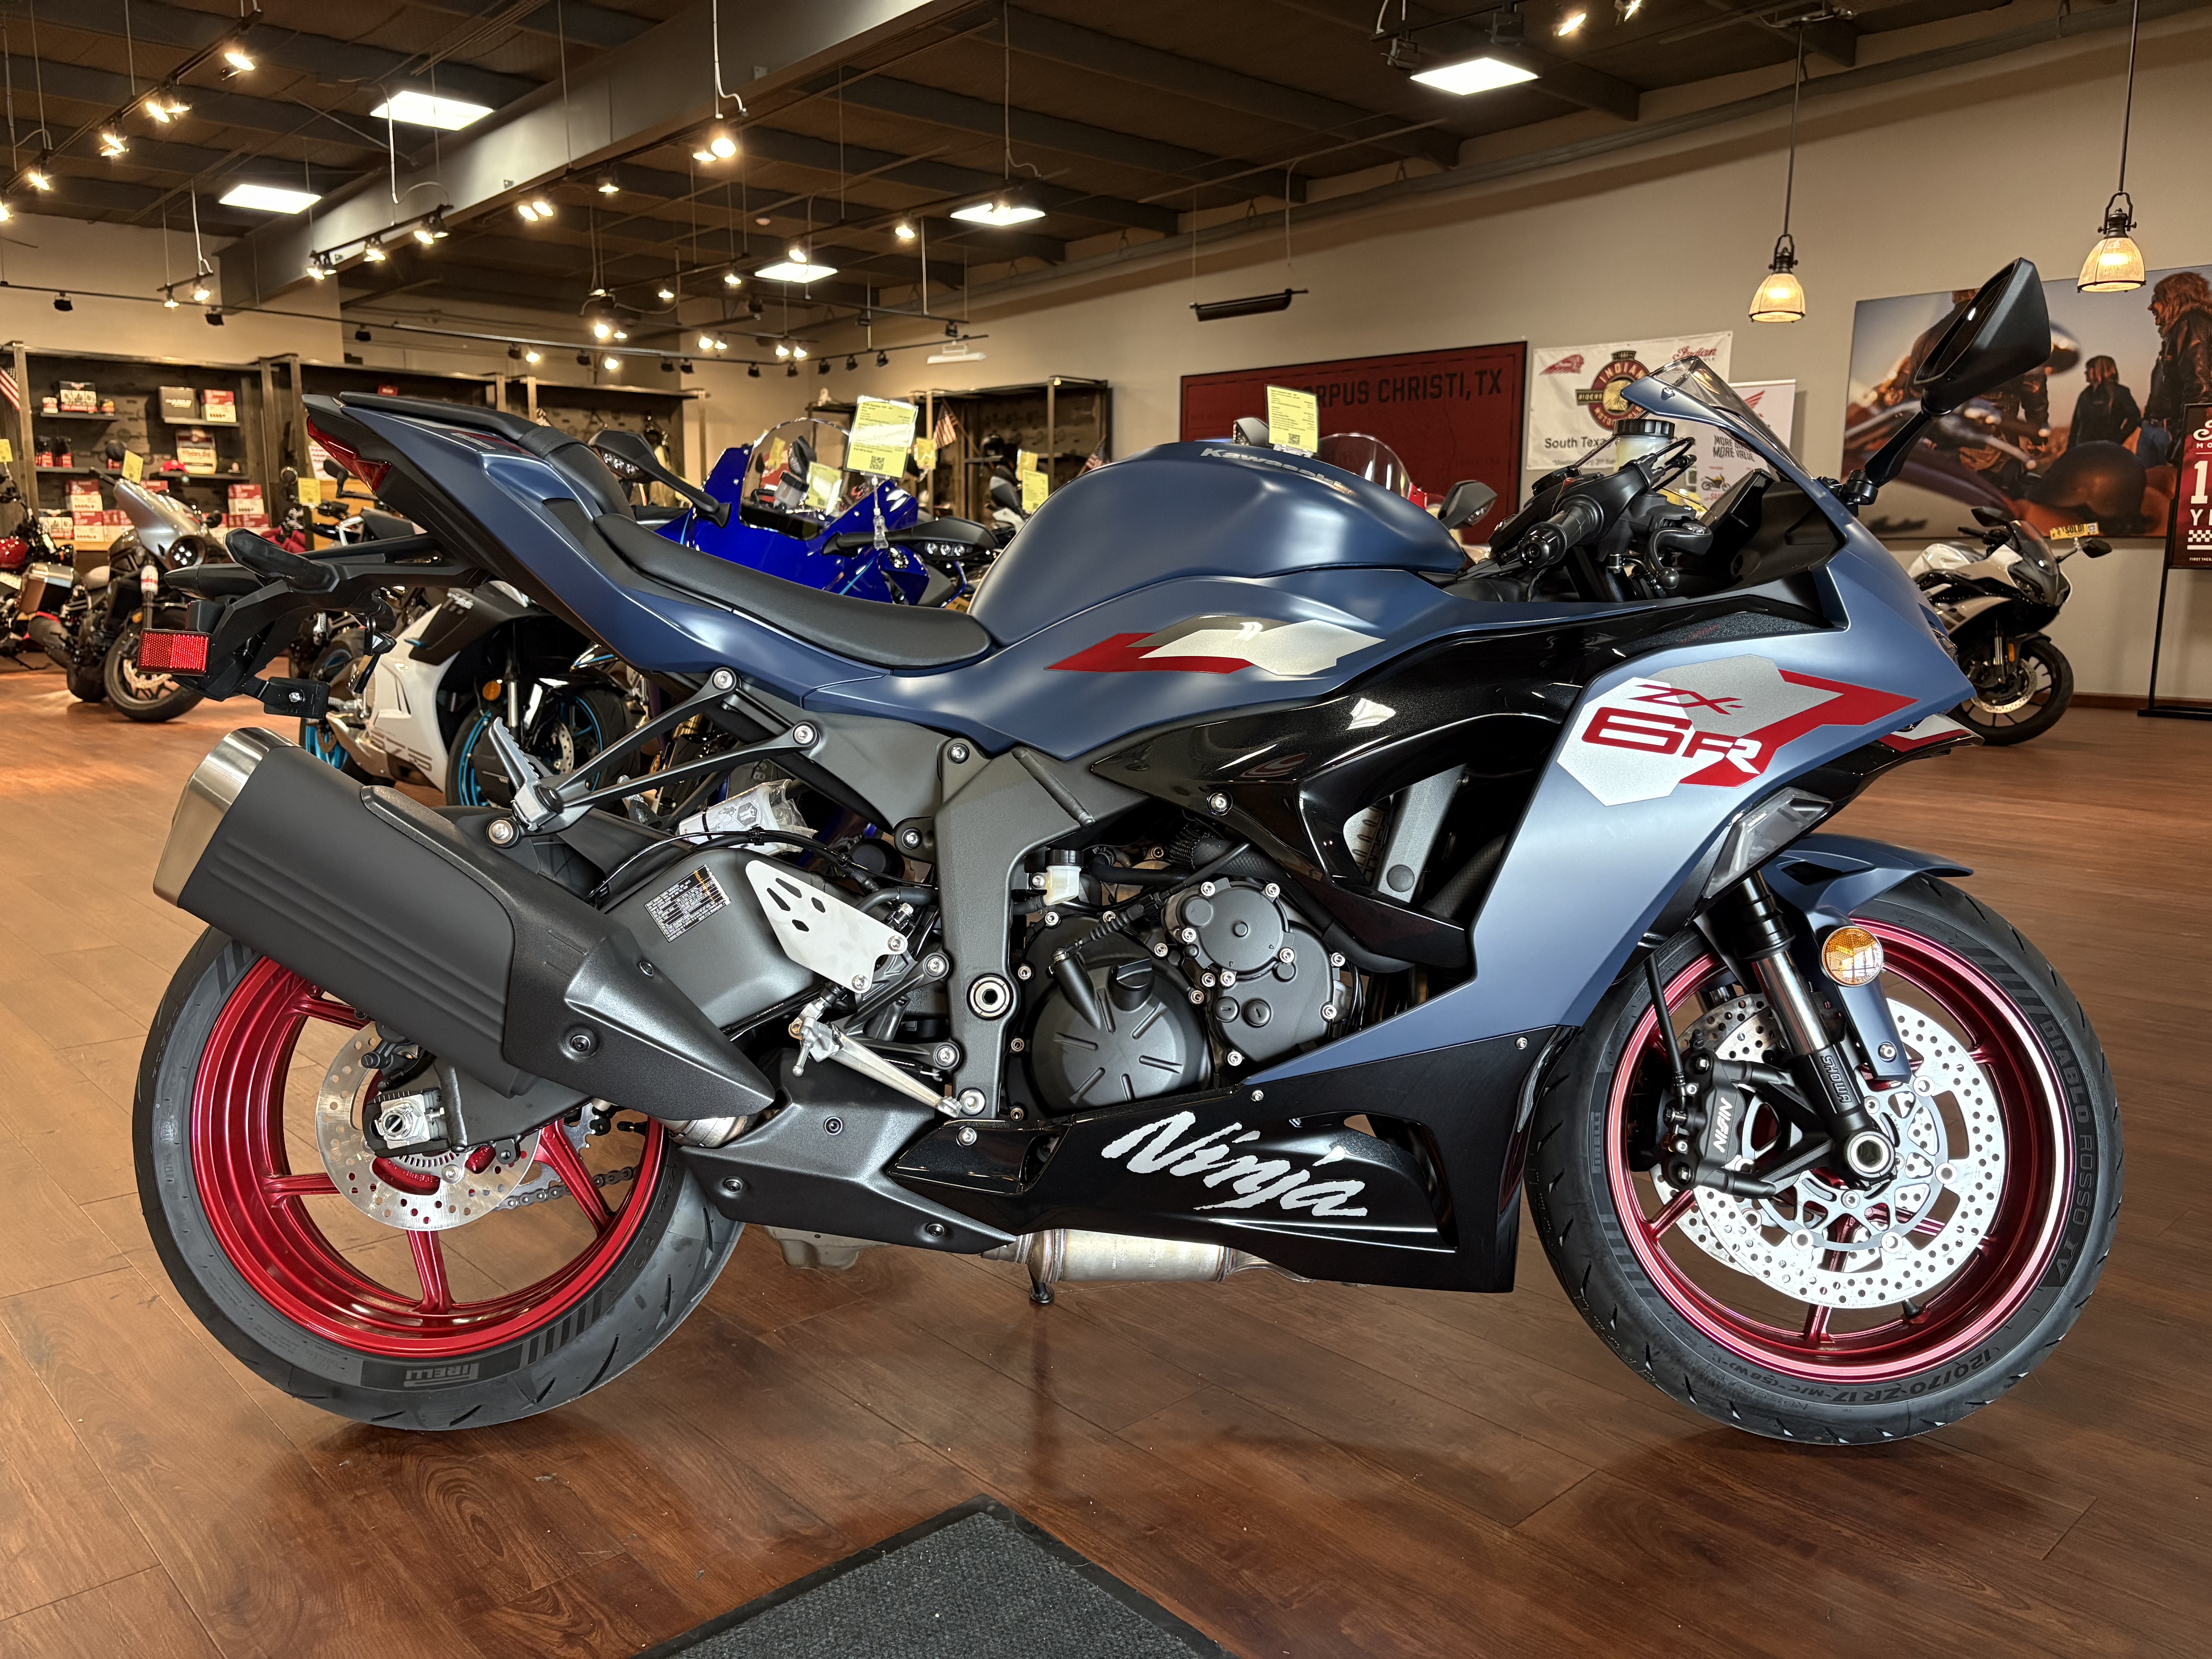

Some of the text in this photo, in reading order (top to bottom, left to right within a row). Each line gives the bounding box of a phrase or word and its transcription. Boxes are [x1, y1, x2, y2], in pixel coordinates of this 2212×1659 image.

[1474, 368, 1503, 396] TX
[1599, 362, 1646, 383] INDIAN
[1577, 393, 1603, 401] RIDERS
[1544, 436, 1608, 449] South Texa
[1713, 446, 1755, 462] MORE VALUE
[1714, 434, 1732, 446] MORE
[1200, 448, 1341, 487] Kawasaki
[1820, 1055, 1852, 1104] SHOWA
[1713, 1097, 1733, 1153] NISSIN
[1587, 1110, 1602, 1174] PIRELLI
[2038, 1013, 2095, 1283] DIABLO ROSSO IV
[1101, 1110, 1368, 1217] Ninja
[403, 1362, 479, 1388] PIRELLI
[1908, 1345, 1994, 1399] 120/70
